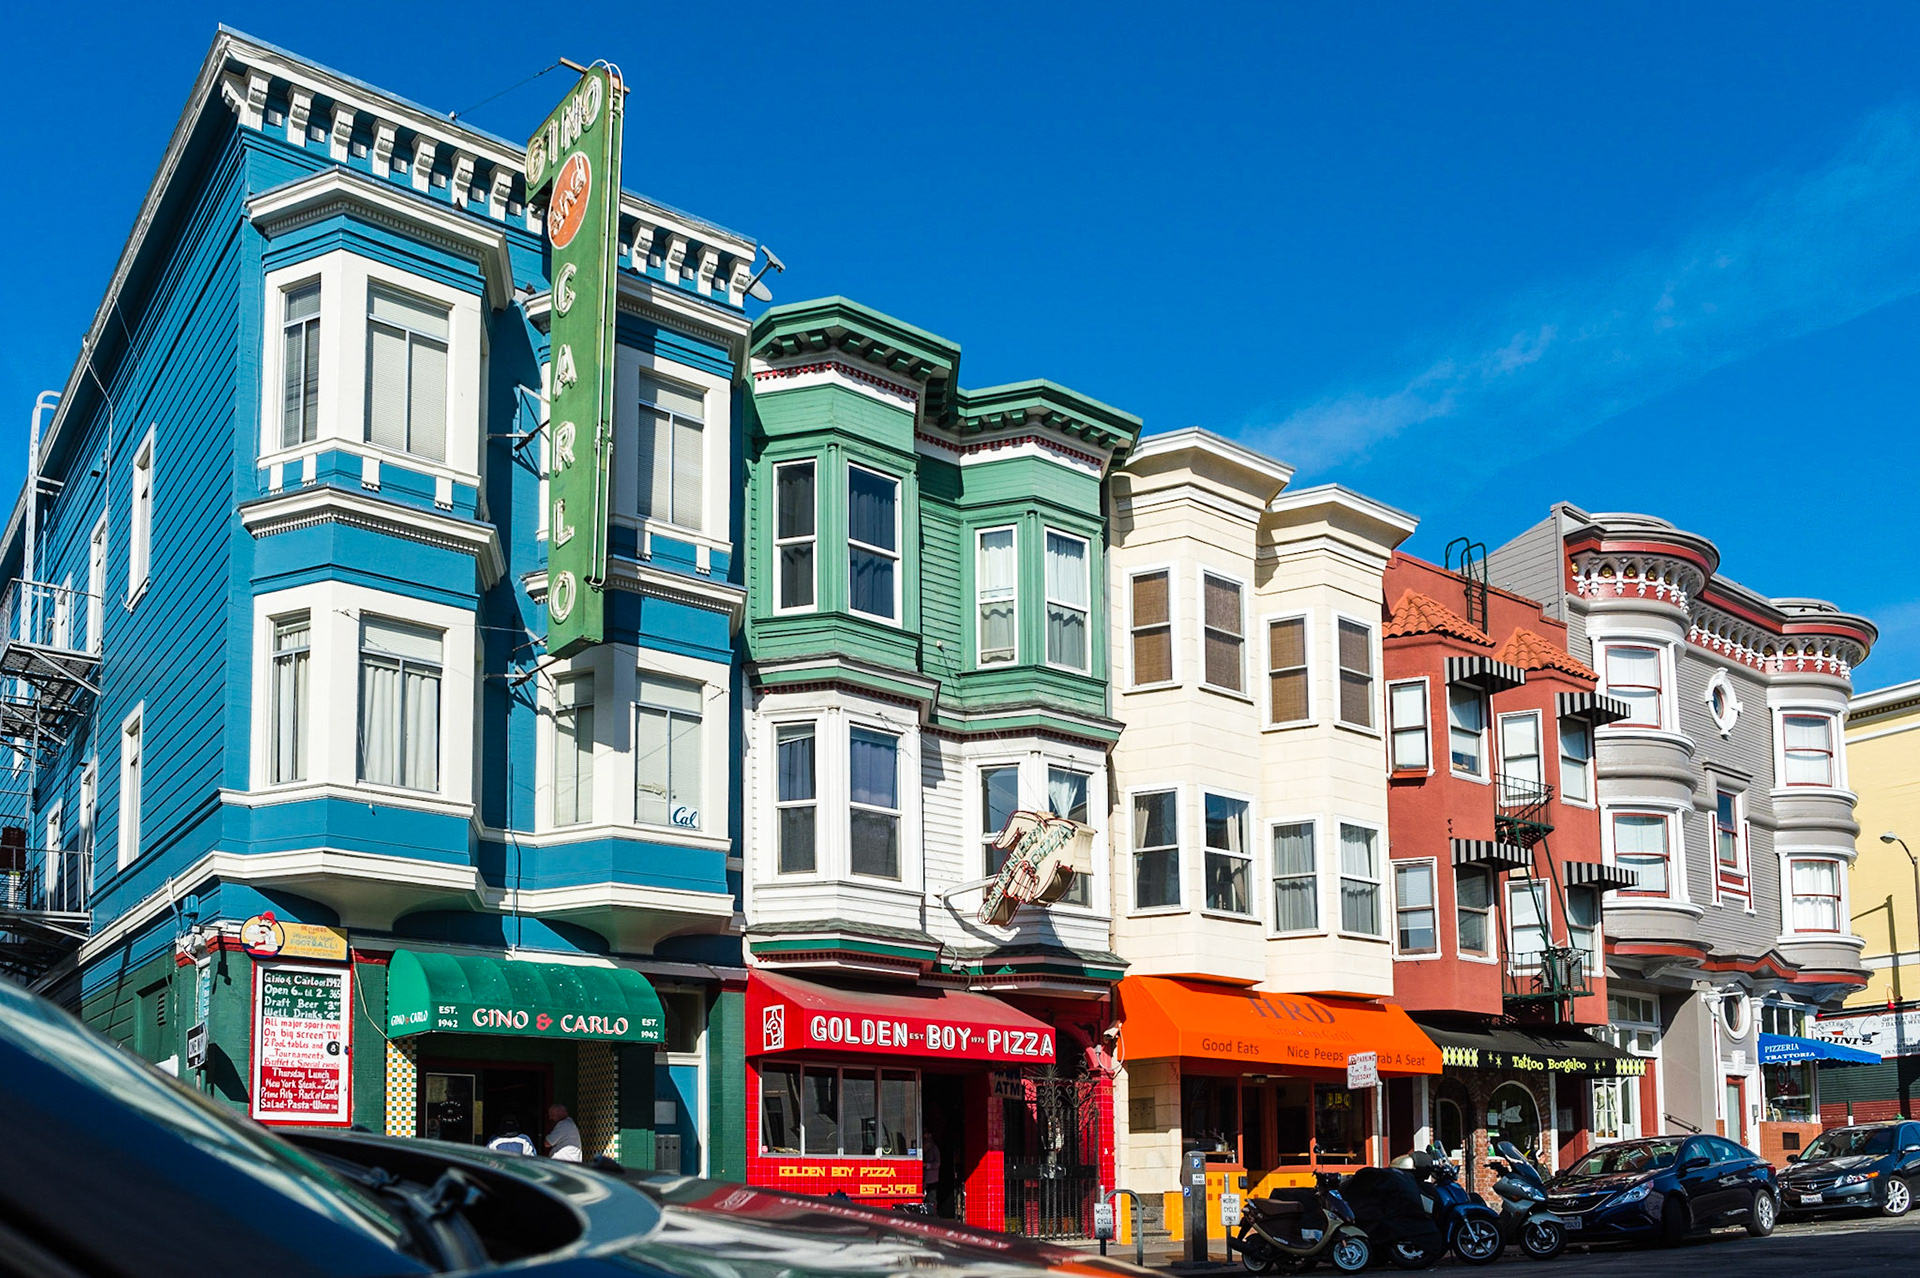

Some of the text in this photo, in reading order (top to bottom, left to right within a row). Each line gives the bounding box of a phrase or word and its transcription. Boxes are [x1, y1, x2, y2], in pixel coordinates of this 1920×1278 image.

[525, 75, 603, 188] GINO
[548, 262, 578, 623] CARLO
[672, 806, 698, 828] Cal
[290, 940, 338, 949] FOOTBALL!
[264, 973, 285, 983] Gino
[264, 984, 288, 996] Open
[264, 996, 290, 1006] Draft
[297, 999, 319, 1008] Beer
[264, 1008, 288, 1017] Well
[294, 1009, 322, 1020] Drinks
[1247, 997, 1336, 1024] HRD
[265, 1018, 277, 1026] All
[281, 1020, 302, 1029] major
[391, 1014, 405, 1027] GINO
[410, 1009, 428, 1023] CARLO
[438, 1006, 628, 1035] EST. GINO & CARLO
[438, 1019, 458, 1028] 1942
[642, 1018, 658, 1027] EST.
[264, 1028, 276, 1037] On
[281, 1029, 294, 1039] big
[296, 1031, 323, 1039] screen
[641, 1030, 658, 1039] 1942
[810, 1016, 908, 1048] GOLDEN
[909, 1032, 924, 1040] EST.
[926, 1024, 971, 1051] BOY
[988, 1029, 1054, 1056] PIZZA
[264, 1038, 270, 1046] 2
[272, 1039, 286, 1047] Pool
[1202, 1038, 1259, 1054] Good Eats
[1816, 1036, 1873, 1045] DINI'S
[1287, 1045, 1344, 1063] Nice Peeps
[1764, 1043, 1799, 1053] PIZZERIA
[1377, 1054, 1425, 1066] rab A Seat
[1765, 1052, 1816, 1060] TRATTORIA
[264, 1057, 289, 1066] Buffet
[298, 1060, 320, 1068] Special
[1512, 1054, 1586, 1073] Tattoo Boogaloo
[272, 1067, 329, 1080] Thursday Lunch
[266, 1078, 280, 1088] New
[281, 1079, 296, 1088] York
[298, 1080, 316, 1089] Steak
[994, 1081, 1020, 1096] ATM
[261, 1087, 278, 1098] Prime
[321, 1090, 338, 1100] Lamb
[779, 1166, 896, 1178] GOLDEN BOY PIZZA
[860, 1184, 917, 1194] EST-1978
